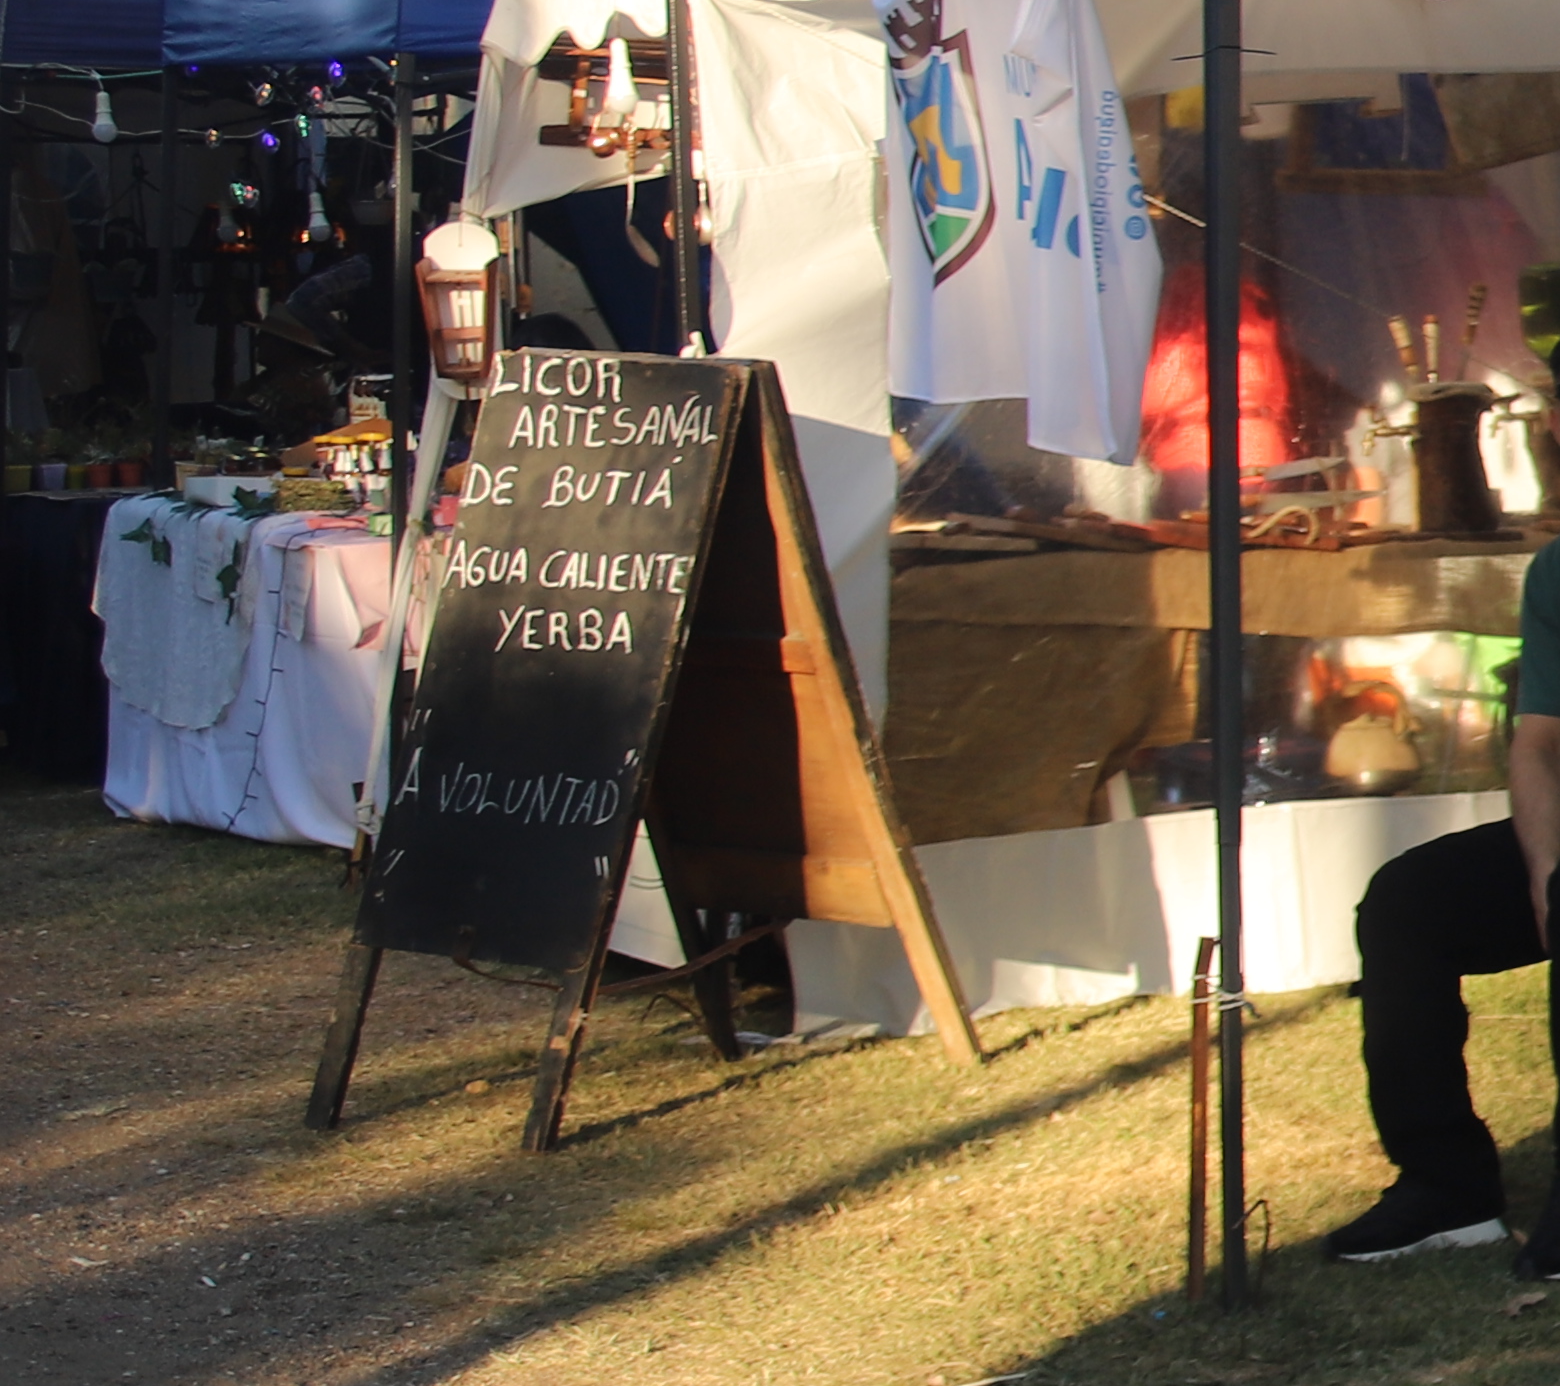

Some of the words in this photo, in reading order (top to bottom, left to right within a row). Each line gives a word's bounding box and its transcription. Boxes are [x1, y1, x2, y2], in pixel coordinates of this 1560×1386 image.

[489, 353, 623, 403] LICOR
[508, 394, 719, 450] ARTESANAL
[460, 462, 520, 508] DE
[541, 455, 684, 509] BUTIÁ
[442, 539, 528, 591] AGUA
[538, 549, 687, 595] CALIENTE
[494, 604, 633, 655] YERBA
